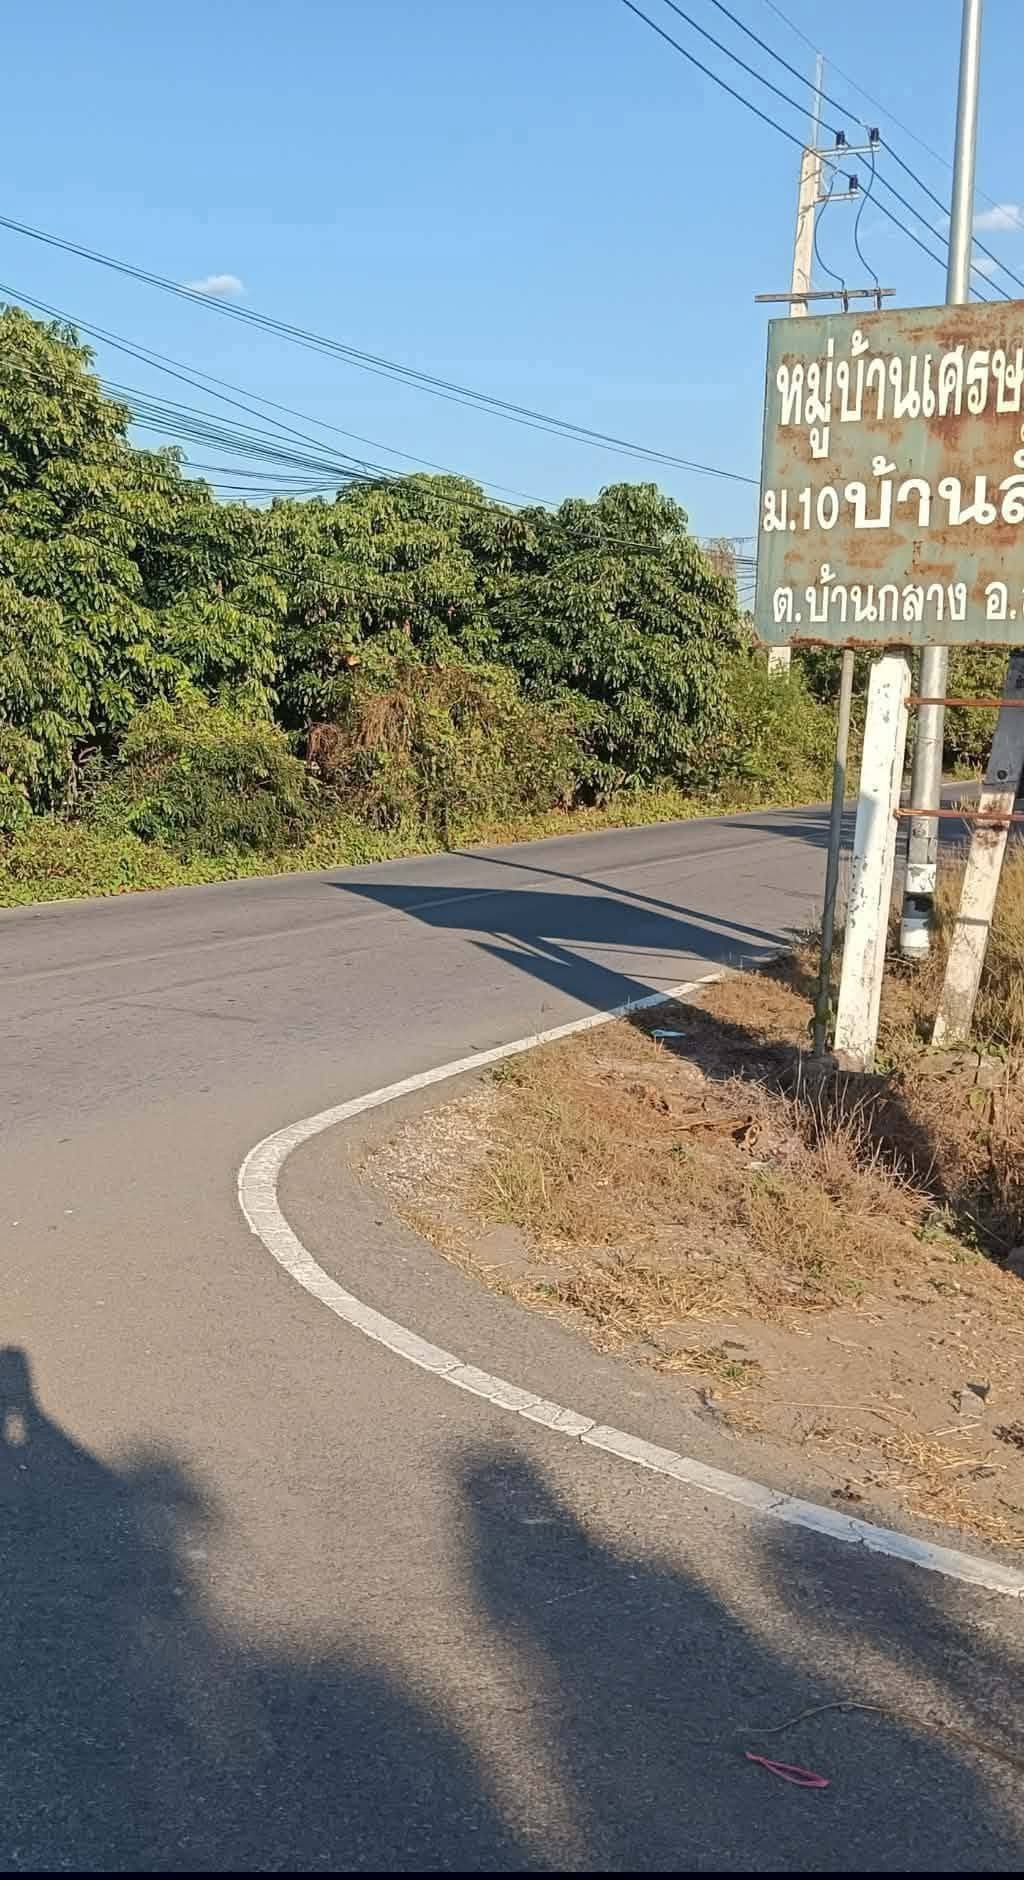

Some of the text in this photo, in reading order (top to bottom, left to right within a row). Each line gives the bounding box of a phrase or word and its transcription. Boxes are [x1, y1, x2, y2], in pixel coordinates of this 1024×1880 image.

[776, 329, 1024, 459] หมู่บ้านเศรษ
[773, 563, 1024, 623] ต.บ้านกลาง อ.
